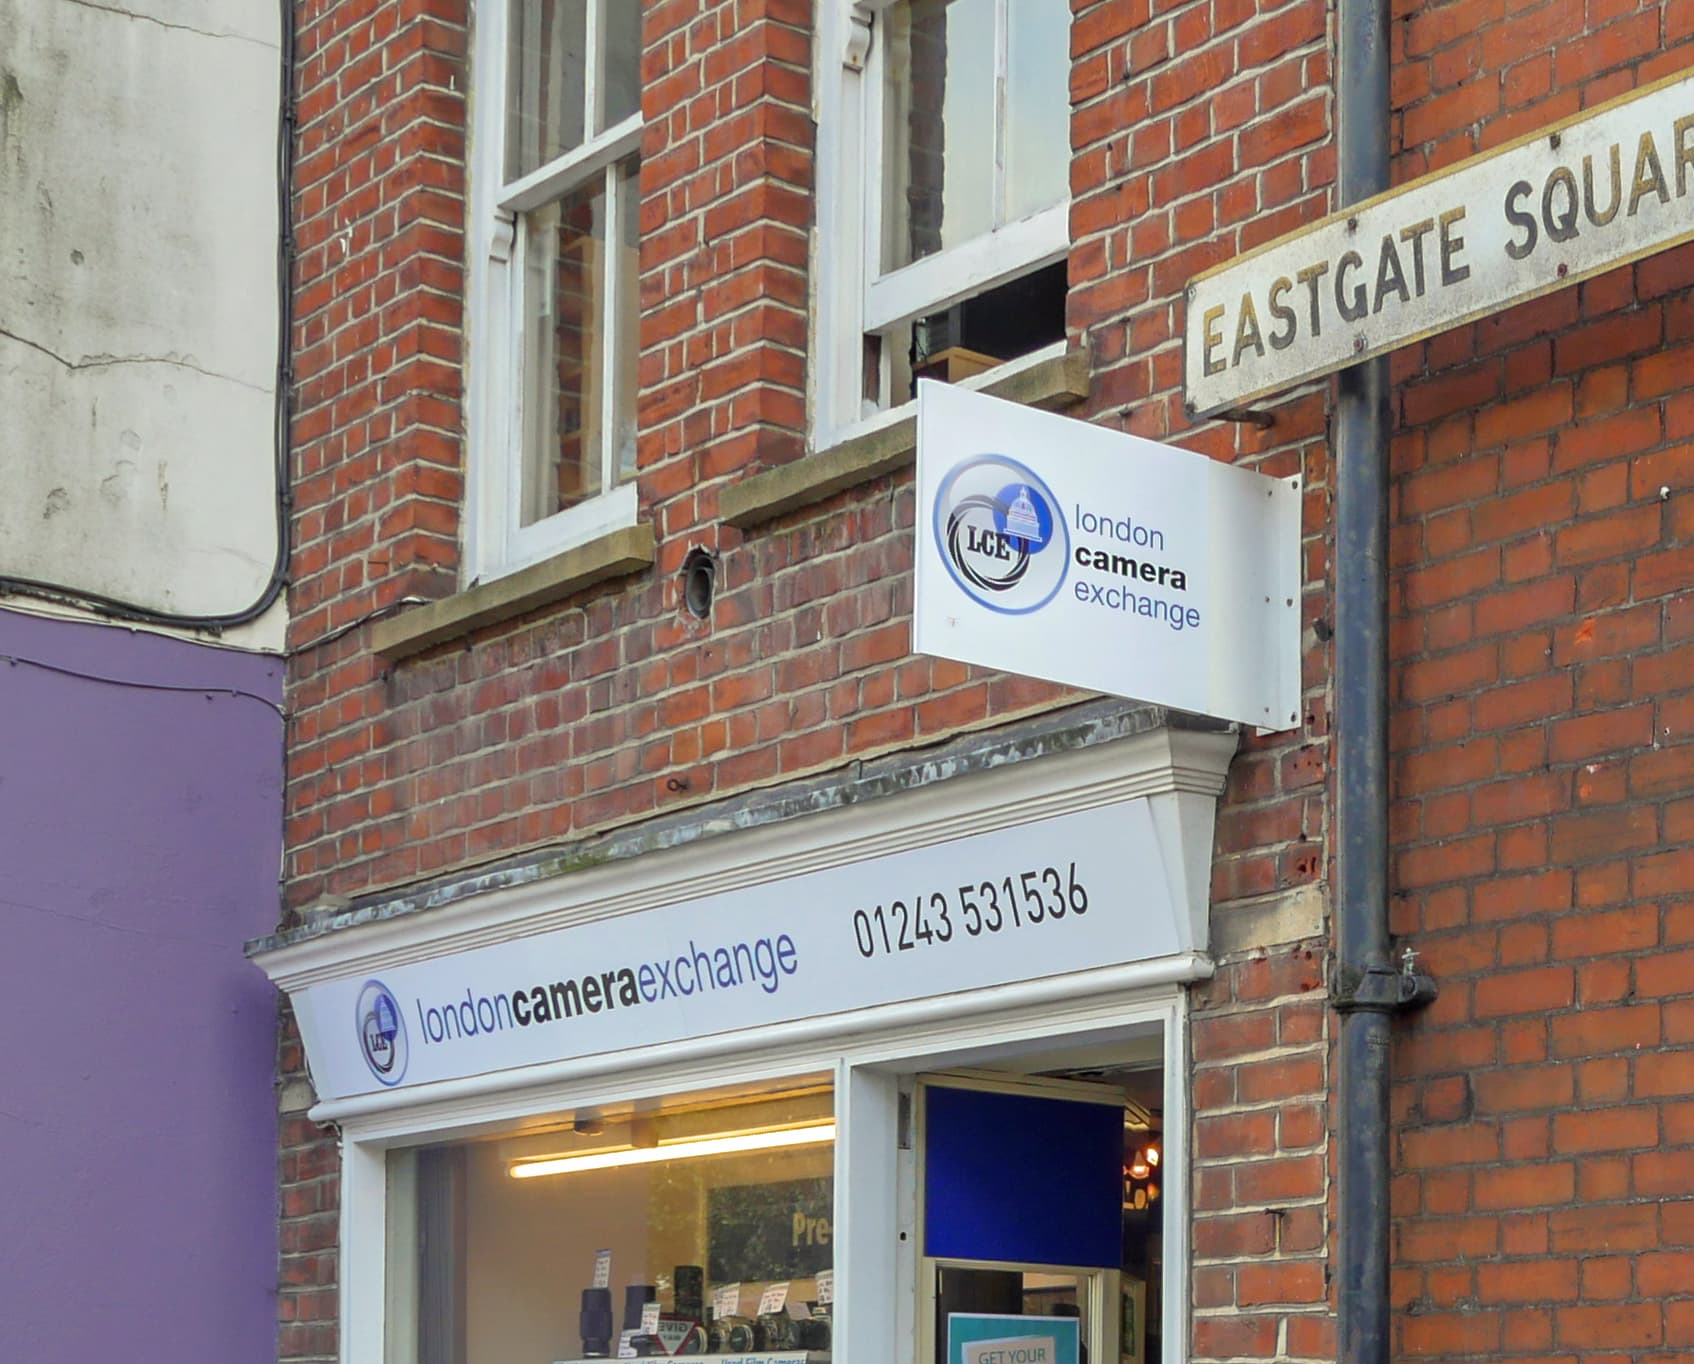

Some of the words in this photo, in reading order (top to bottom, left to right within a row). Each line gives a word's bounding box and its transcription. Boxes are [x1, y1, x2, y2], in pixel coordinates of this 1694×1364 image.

[1203, 205, 1470, 377] EASTGATE
[966, 525, 1011, 562] LCE
[1075, 504, 1164, 551] london
[1075, 546, 1187, 591] camera
[1074, 579, 1200, 631] exchange
[417, 930, 799, 1046] londoncameraexchange
[854, 893, 953, 959] 01243
[958, 862, 1090, 937] 531536
[1009, 1348, 1046, 1363] YOUR
